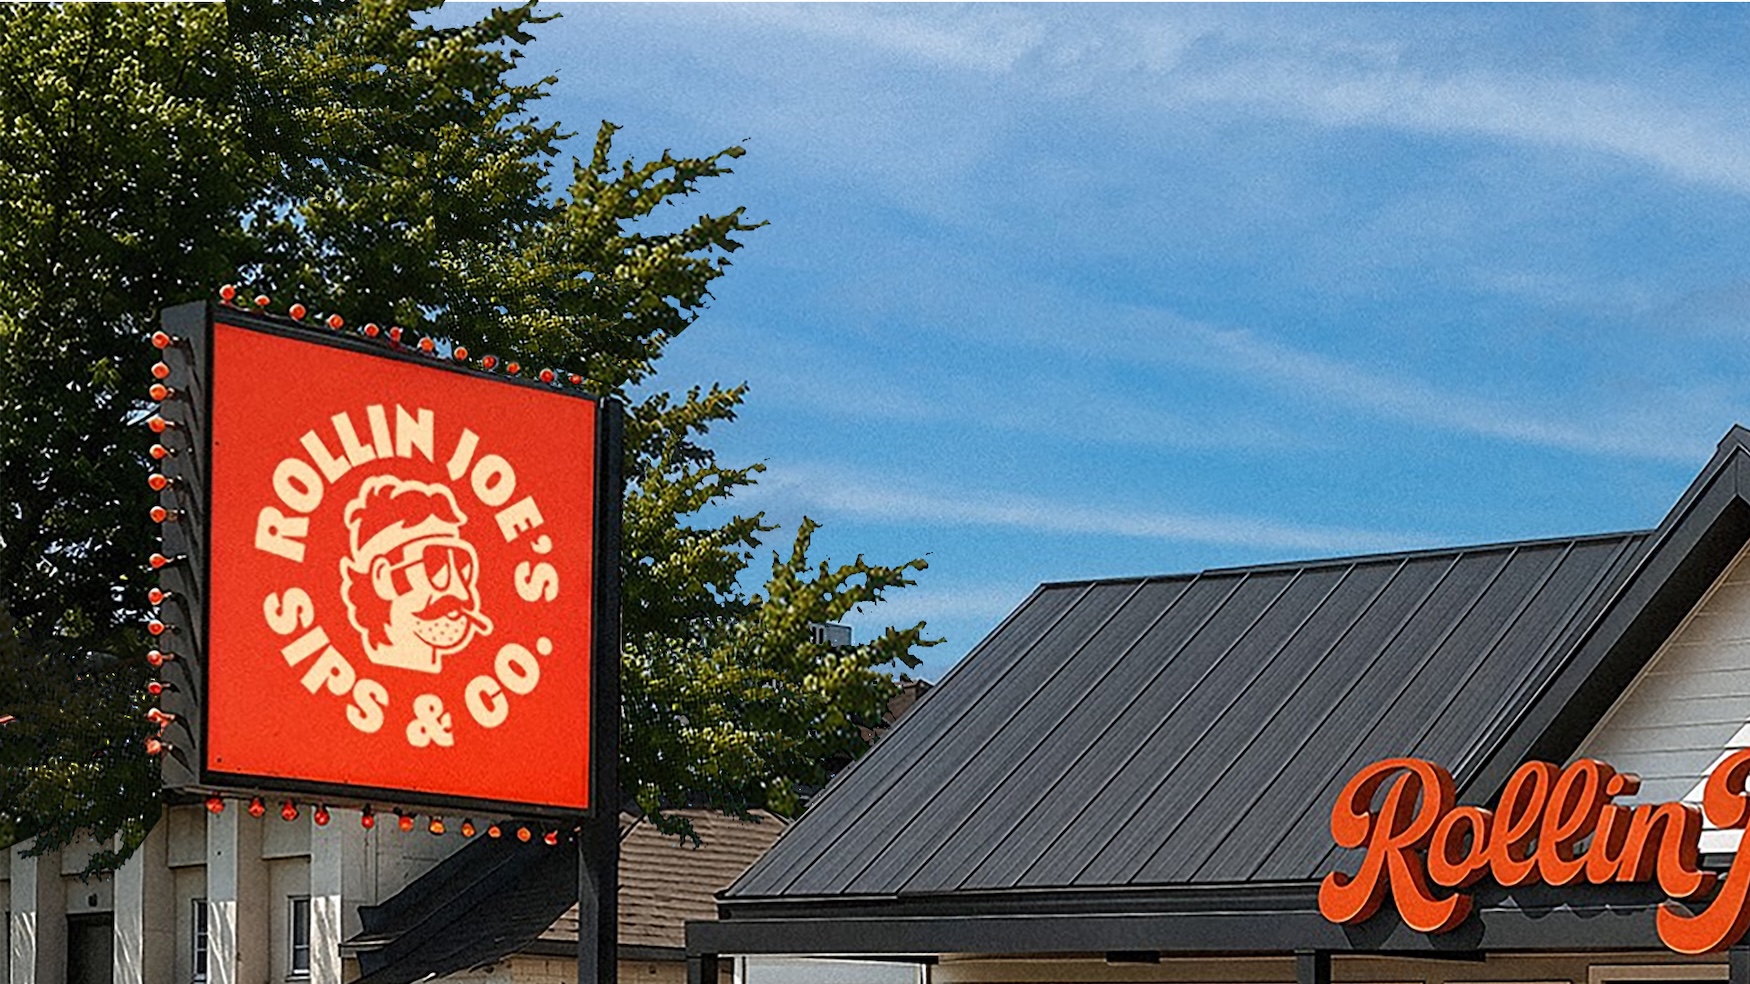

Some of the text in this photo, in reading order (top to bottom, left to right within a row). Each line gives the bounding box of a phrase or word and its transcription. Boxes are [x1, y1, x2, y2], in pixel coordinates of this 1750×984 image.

[254, 403, 560, 604] ROLLIN JOE'S
[262, 586, 554, 749] SIPS & CO.
[1318, 756, 1717, 934] Rollin
